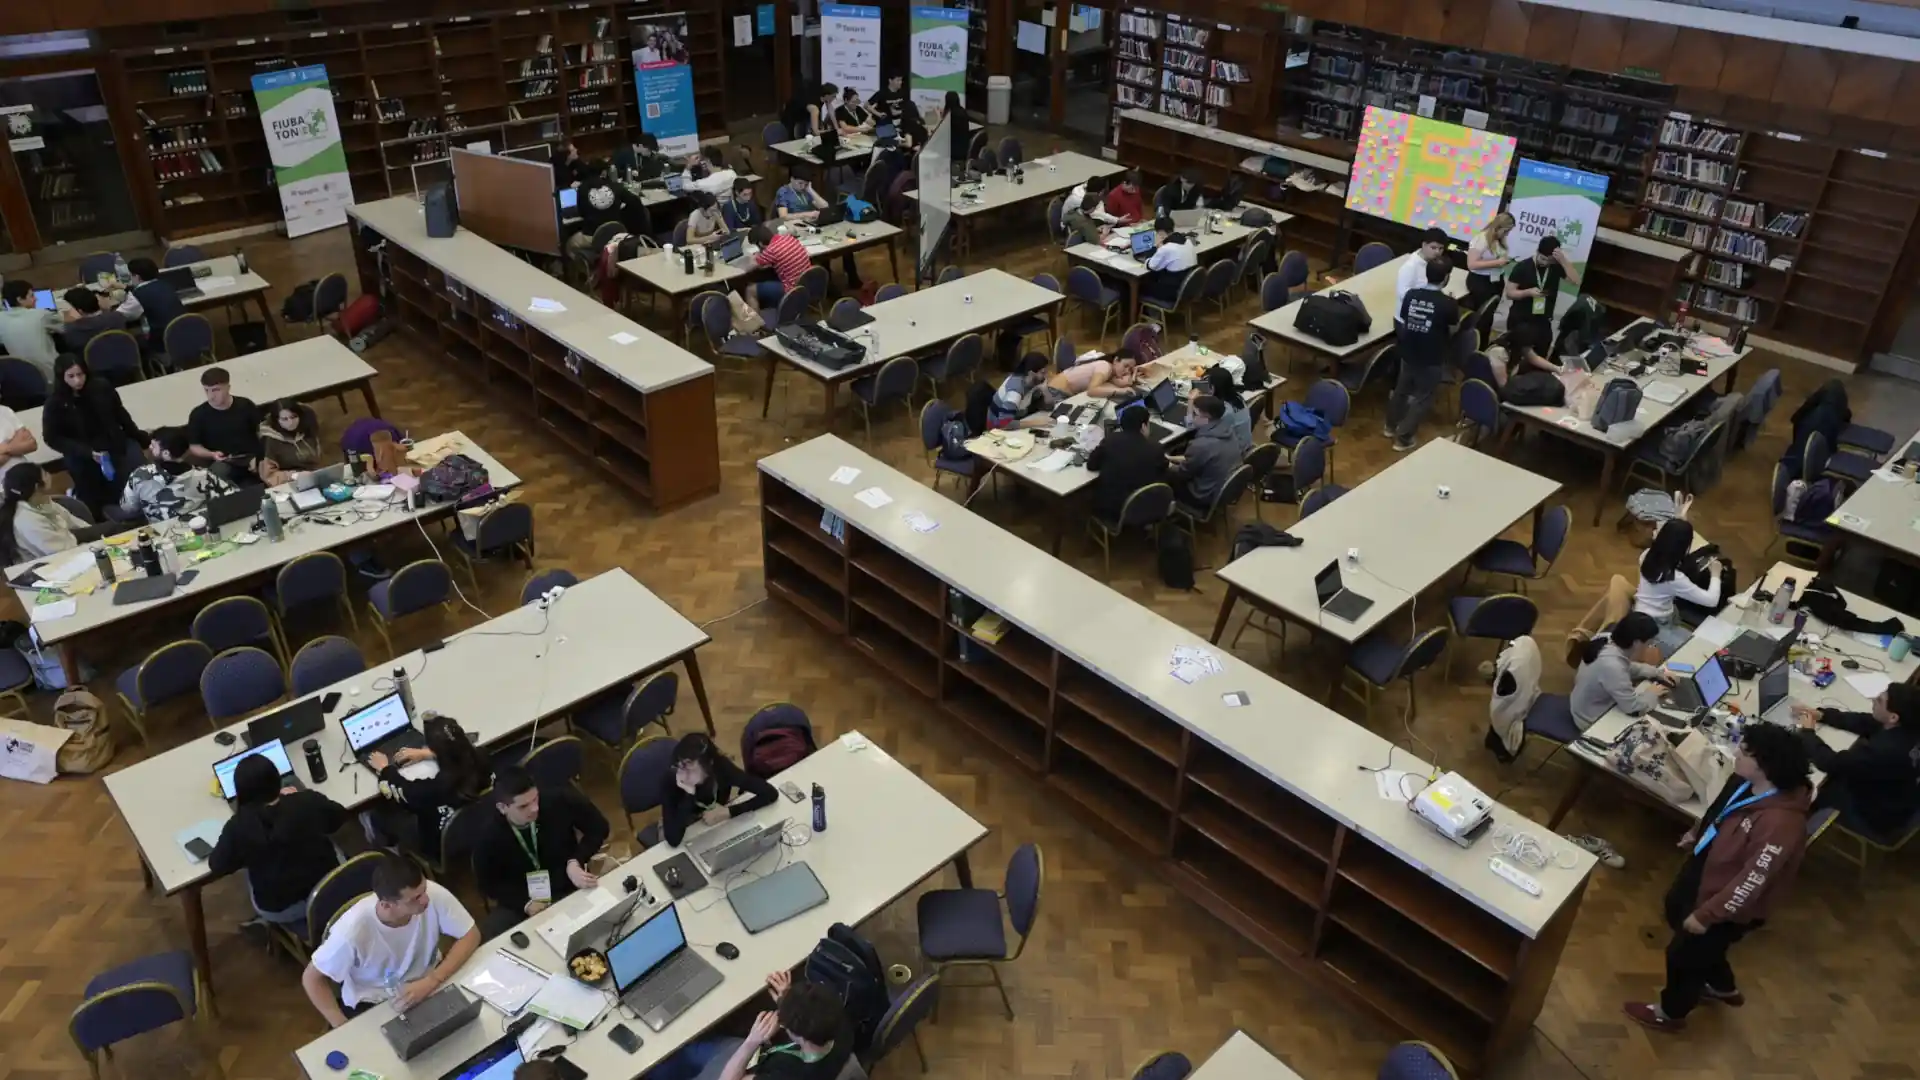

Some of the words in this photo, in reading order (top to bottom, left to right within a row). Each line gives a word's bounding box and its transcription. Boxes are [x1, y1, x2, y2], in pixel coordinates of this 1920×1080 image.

[918, 41, 943, 51] FIUBA
[919, 50, 937, 58] TON
[272, 115, 305, 131] FIUBA
[275, 127, 299, 141] TON
[1519, 211, 1557, 229] FIUBA
[1518, 222, 1545, 237] TON
[1755, 842, 1783, 871] Los
